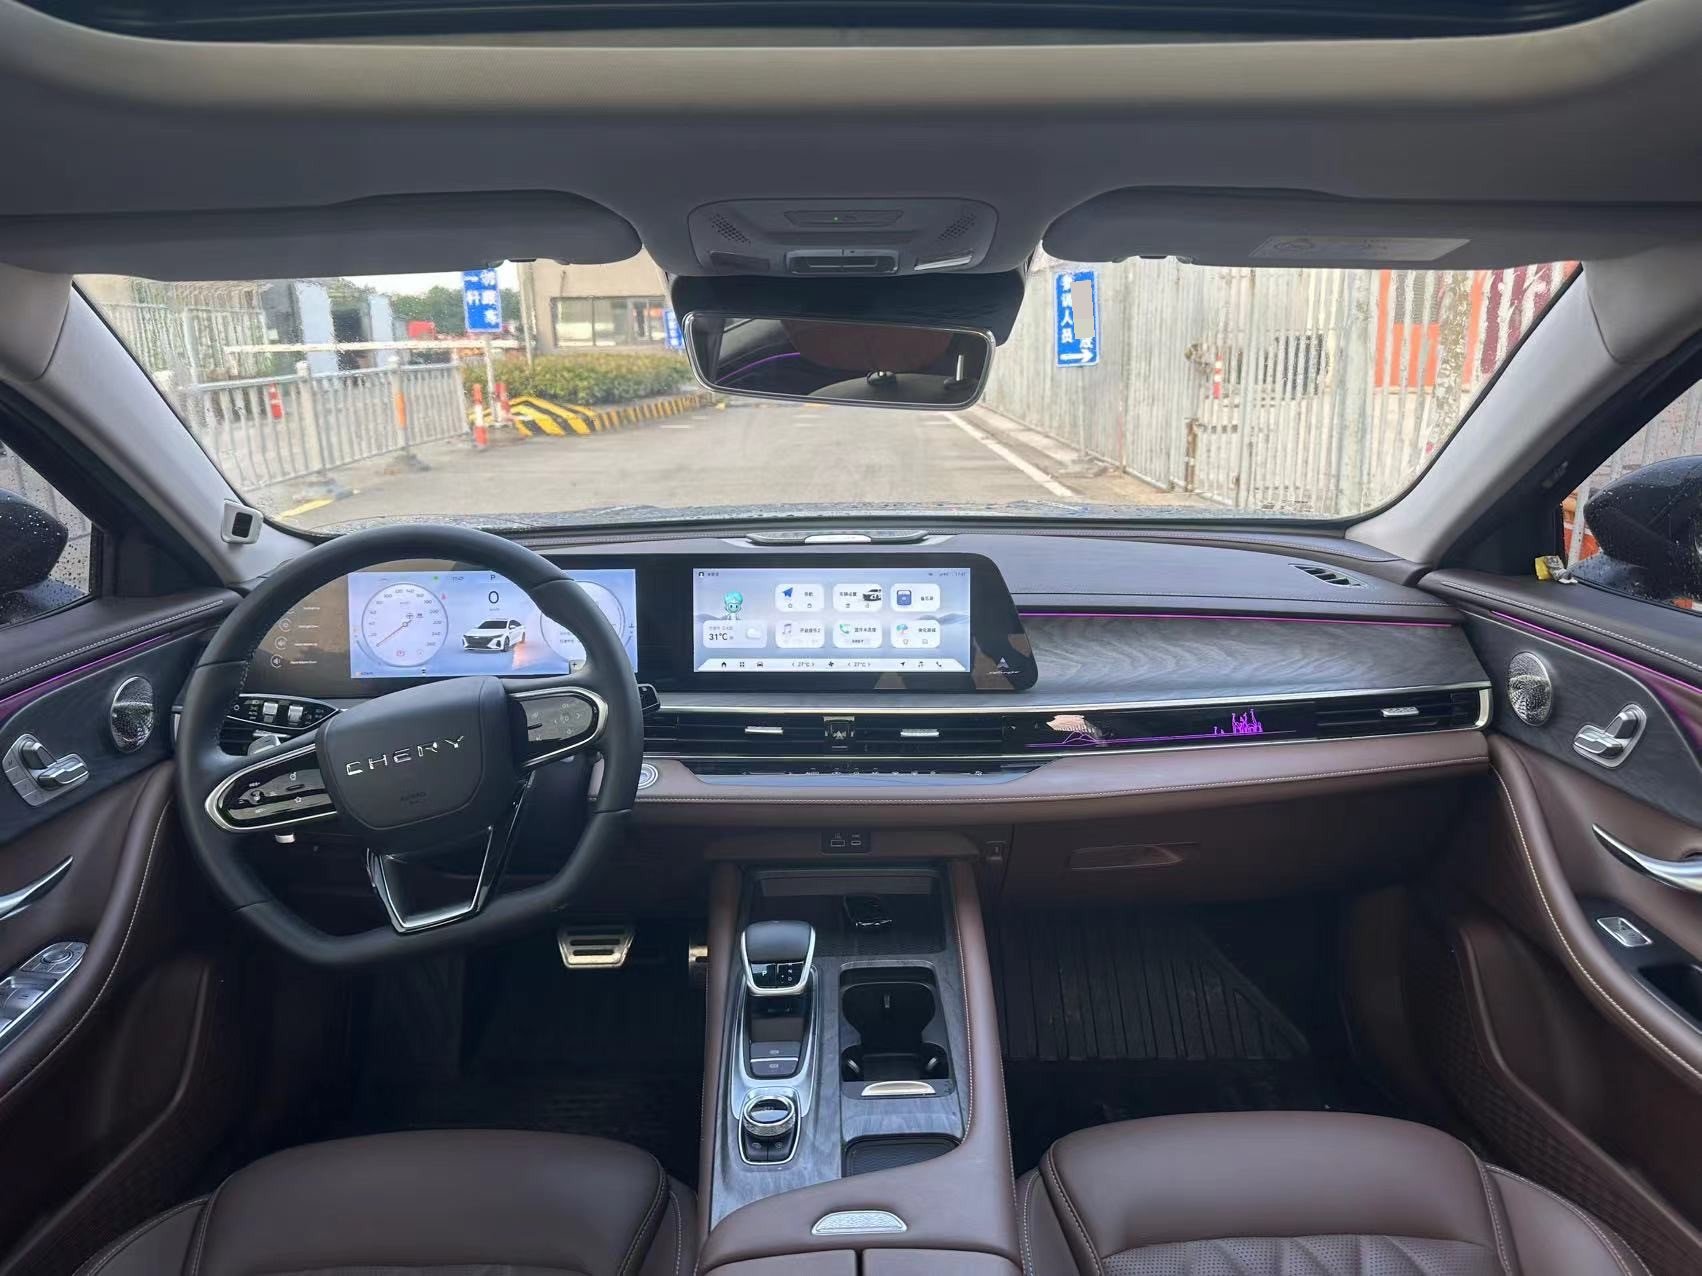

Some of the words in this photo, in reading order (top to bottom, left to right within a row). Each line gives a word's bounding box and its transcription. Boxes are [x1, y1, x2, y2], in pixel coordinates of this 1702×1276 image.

[488, 590, 500, 604] 0
[708, 632, 728, 640] 31°C
[346, 736, 464, 776] CHERY
